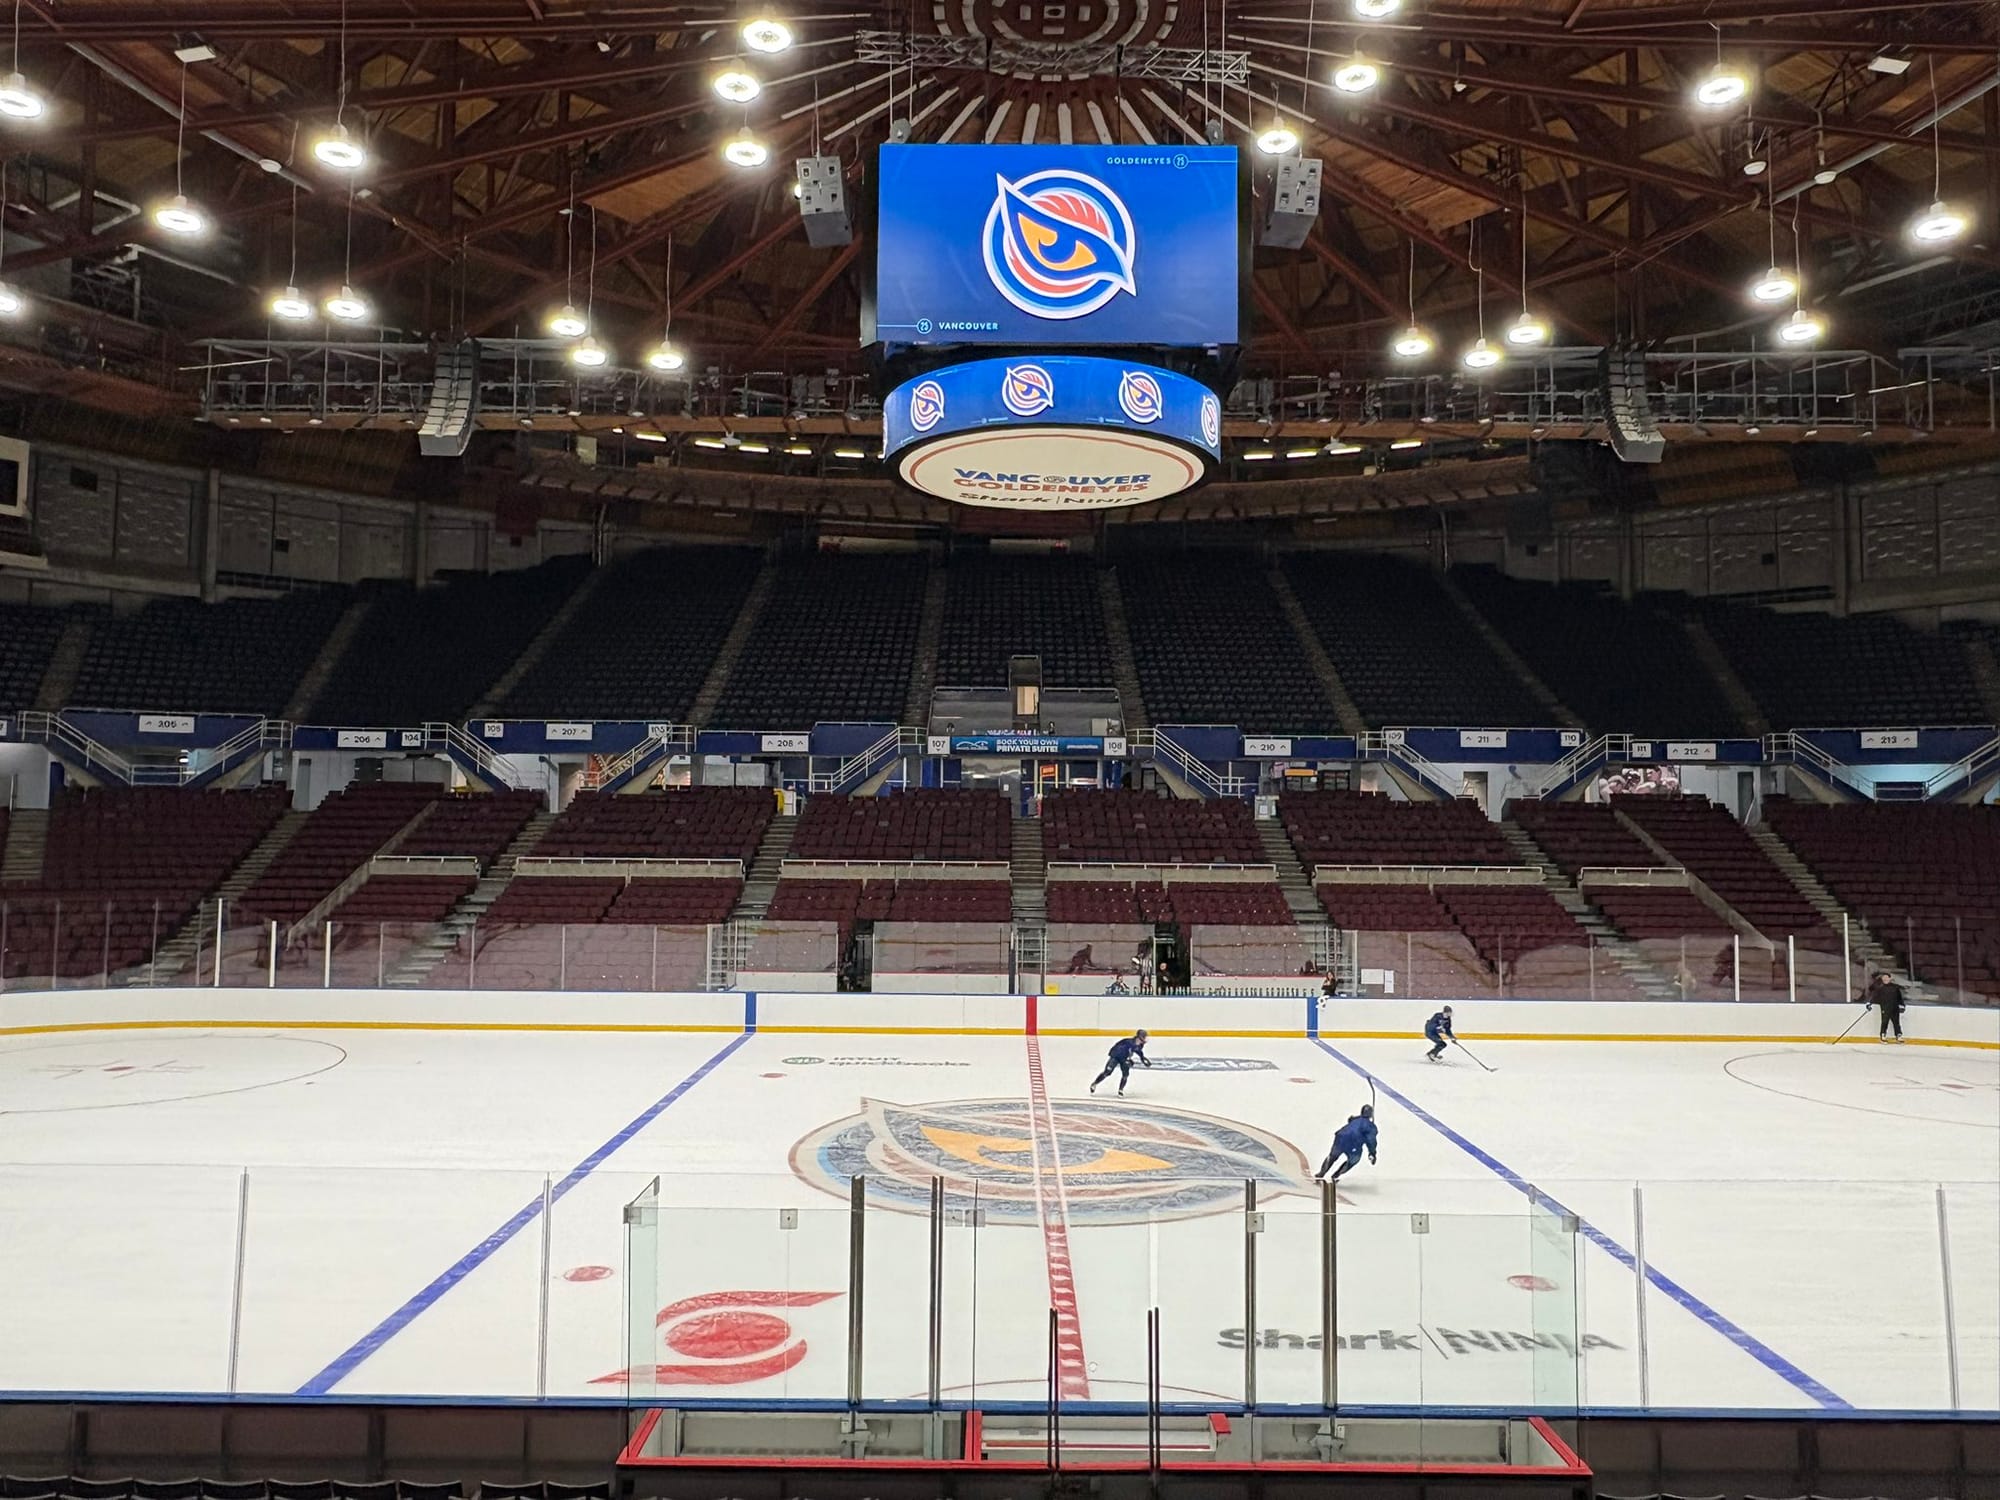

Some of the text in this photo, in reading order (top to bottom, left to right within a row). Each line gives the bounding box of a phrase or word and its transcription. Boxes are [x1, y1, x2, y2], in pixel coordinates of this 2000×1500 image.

[1106, 157, 1171, 165] GOLDENEYES
[938, 322, 999, 330] VANCOUVER
[953, 479, 1148, 493] GOLDENEYES
[561, 728, 577, 736] 207
[1387, 732, 1402, 740] 109
[353, 735, 371, 744] 206
[404, 734, 419, 742] 104
[1880, 736, 1897, 744] 213
[777, 739, 794, 748] 208
[932, 740, 946, 748] 107
[1108, 742, 1123, 750] 108
[1260, 743, 1276, 751] 210
[996, 745, 1031, 753] PRIVATE
[1216, 1328, 1422, 1351] Shark
